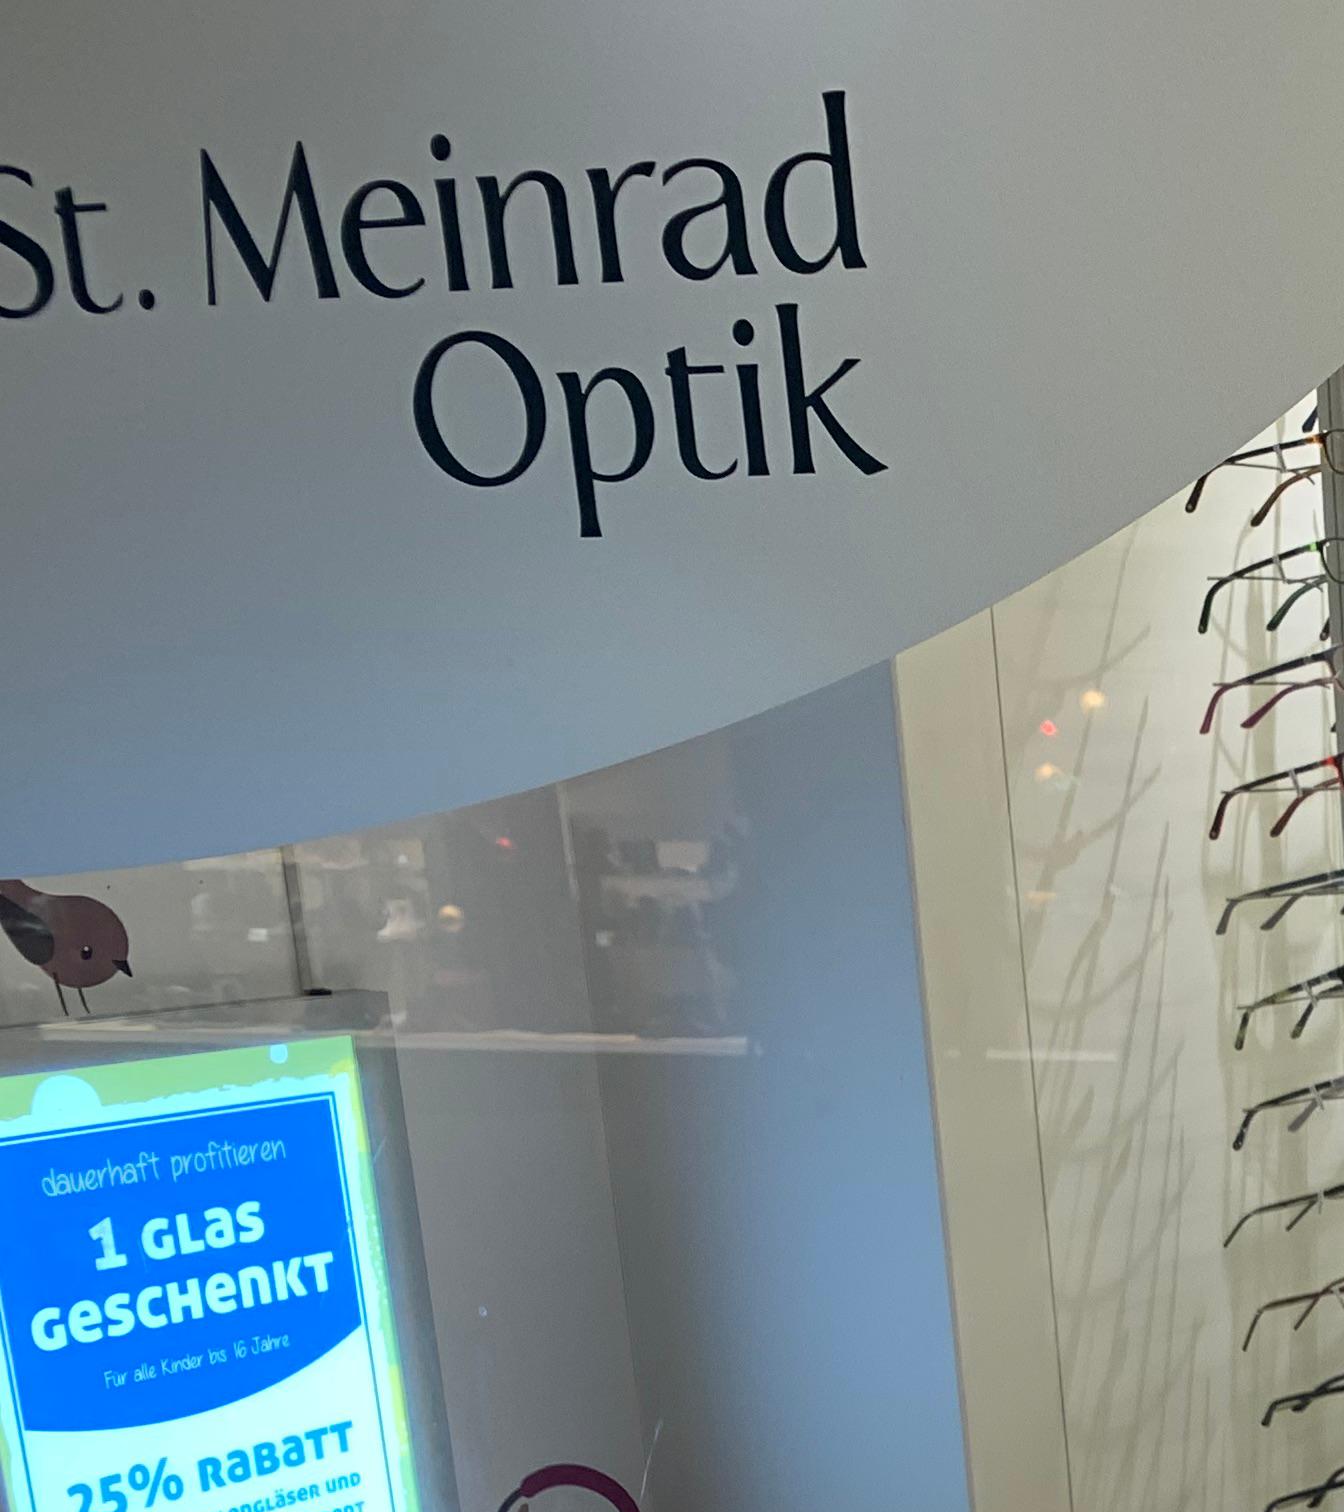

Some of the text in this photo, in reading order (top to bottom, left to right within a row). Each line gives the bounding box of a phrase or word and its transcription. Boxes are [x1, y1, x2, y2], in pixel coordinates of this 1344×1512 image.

[0, 90, 867, 319] St. Meinrad
[412, 303, 889, 539] Optik
[41, 1139, 287, 1197] dauerhaft profitieren
[88, 1216, 128, 1271] 1
[104, 1333, 290, 1390] Für alle Kinder bis 16 Jahre
